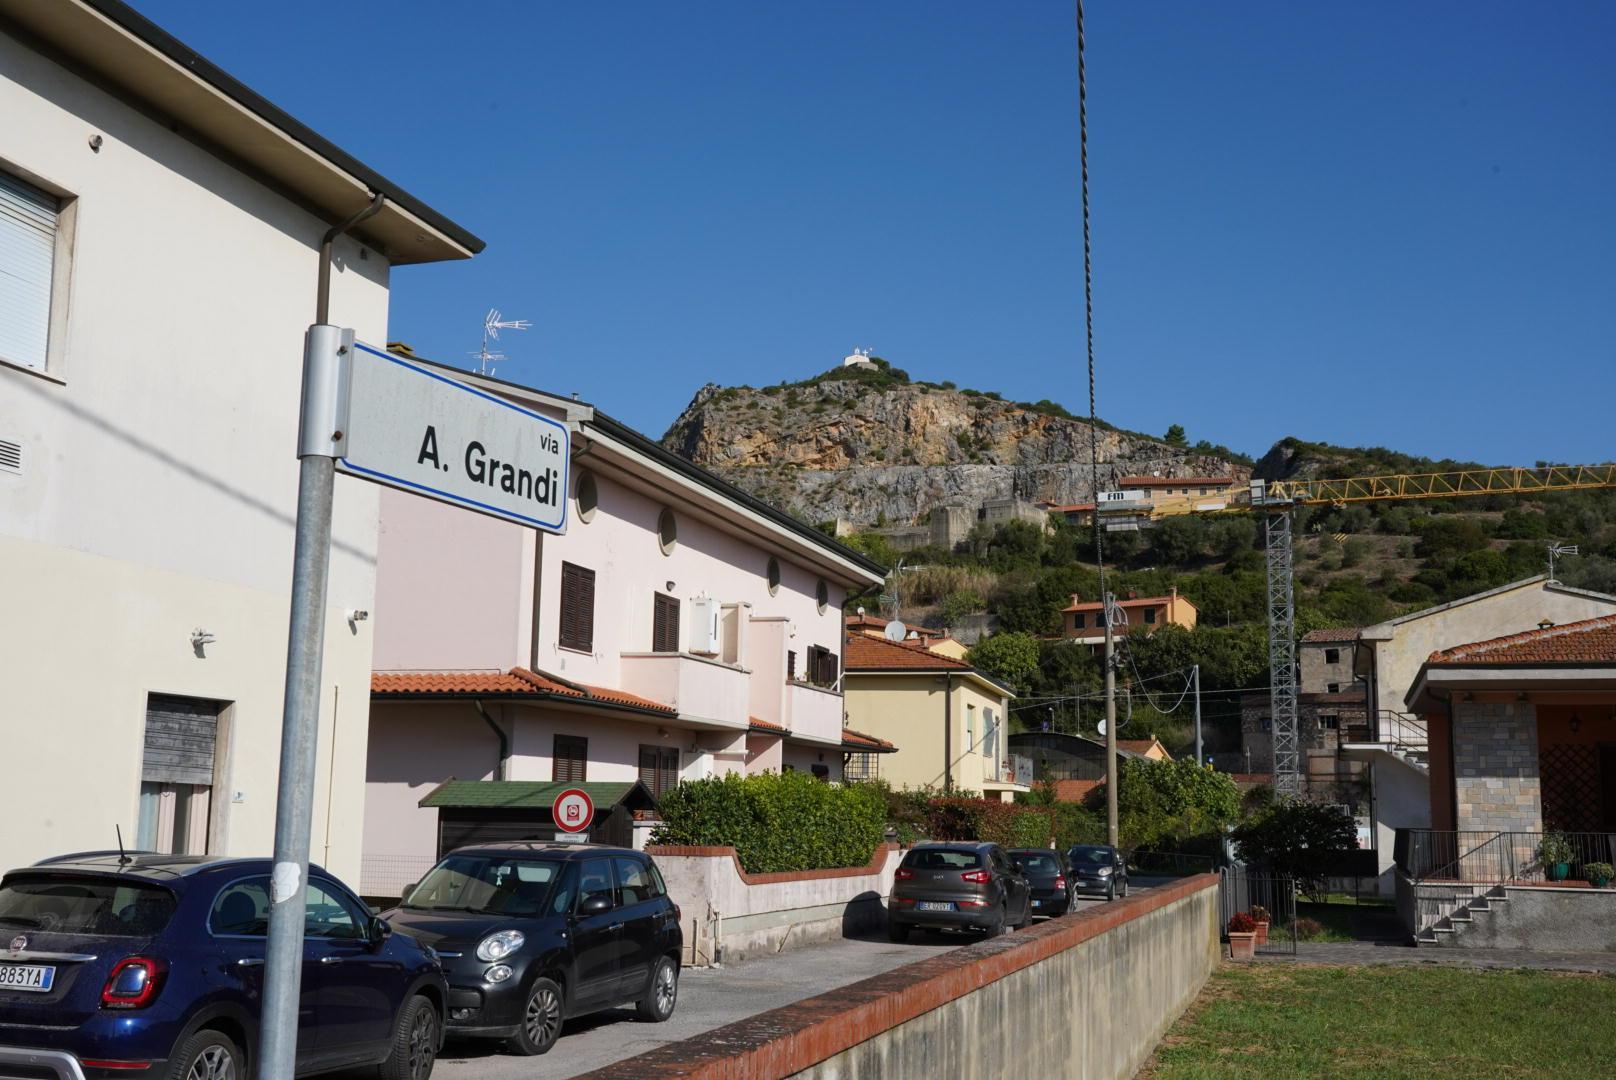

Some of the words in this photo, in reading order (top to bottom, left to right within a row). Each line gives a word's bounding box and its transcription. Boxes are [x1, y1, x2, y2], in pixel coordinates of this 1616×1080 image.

[417, 425, 449, 472] A.
[464, 441, 558, 507] Grandi
[540, 433, 559, 454] via
